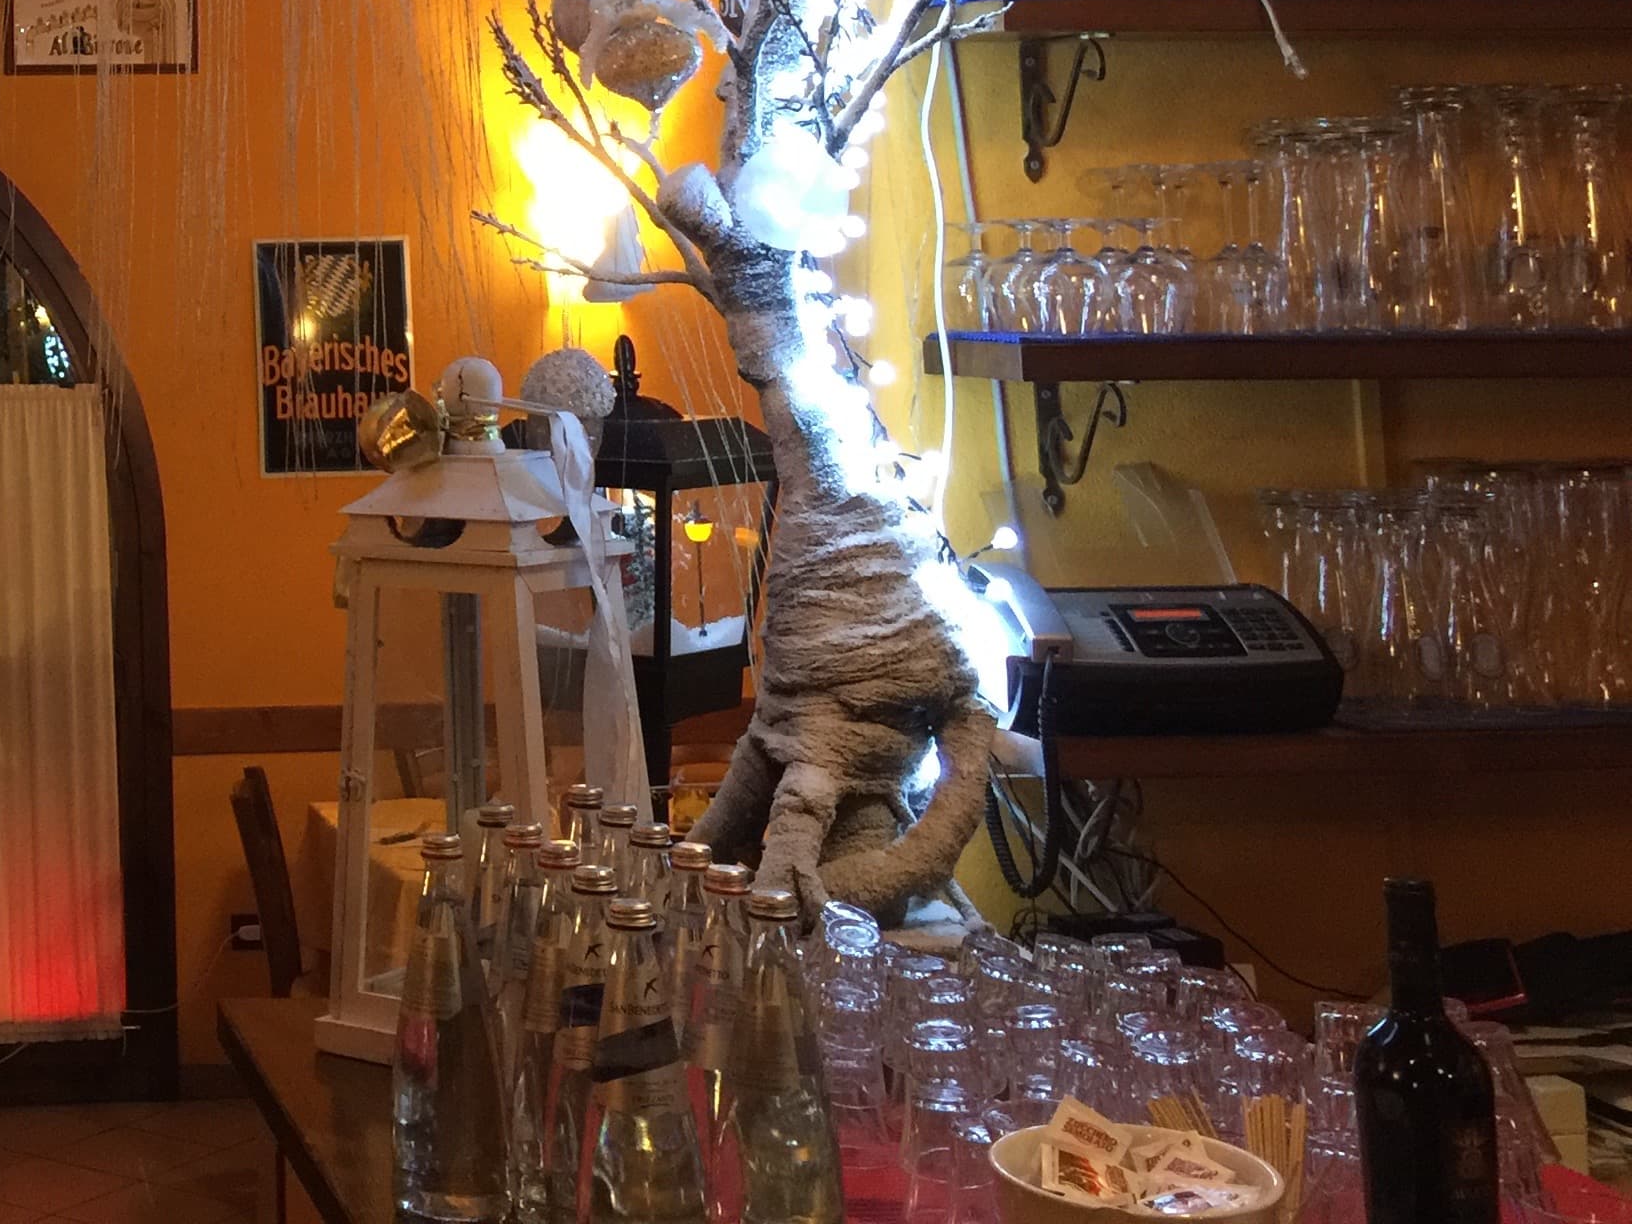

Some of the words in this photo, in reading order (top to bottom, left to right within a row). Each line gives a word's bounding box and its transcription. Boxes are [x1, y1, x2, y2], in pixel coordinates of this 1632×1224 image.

[263, 333, 409, 387] Bayerisches
[276, 384, 397, 420] Brauha
[1065, 1117, 1118, 1146] ZUCCHERO
